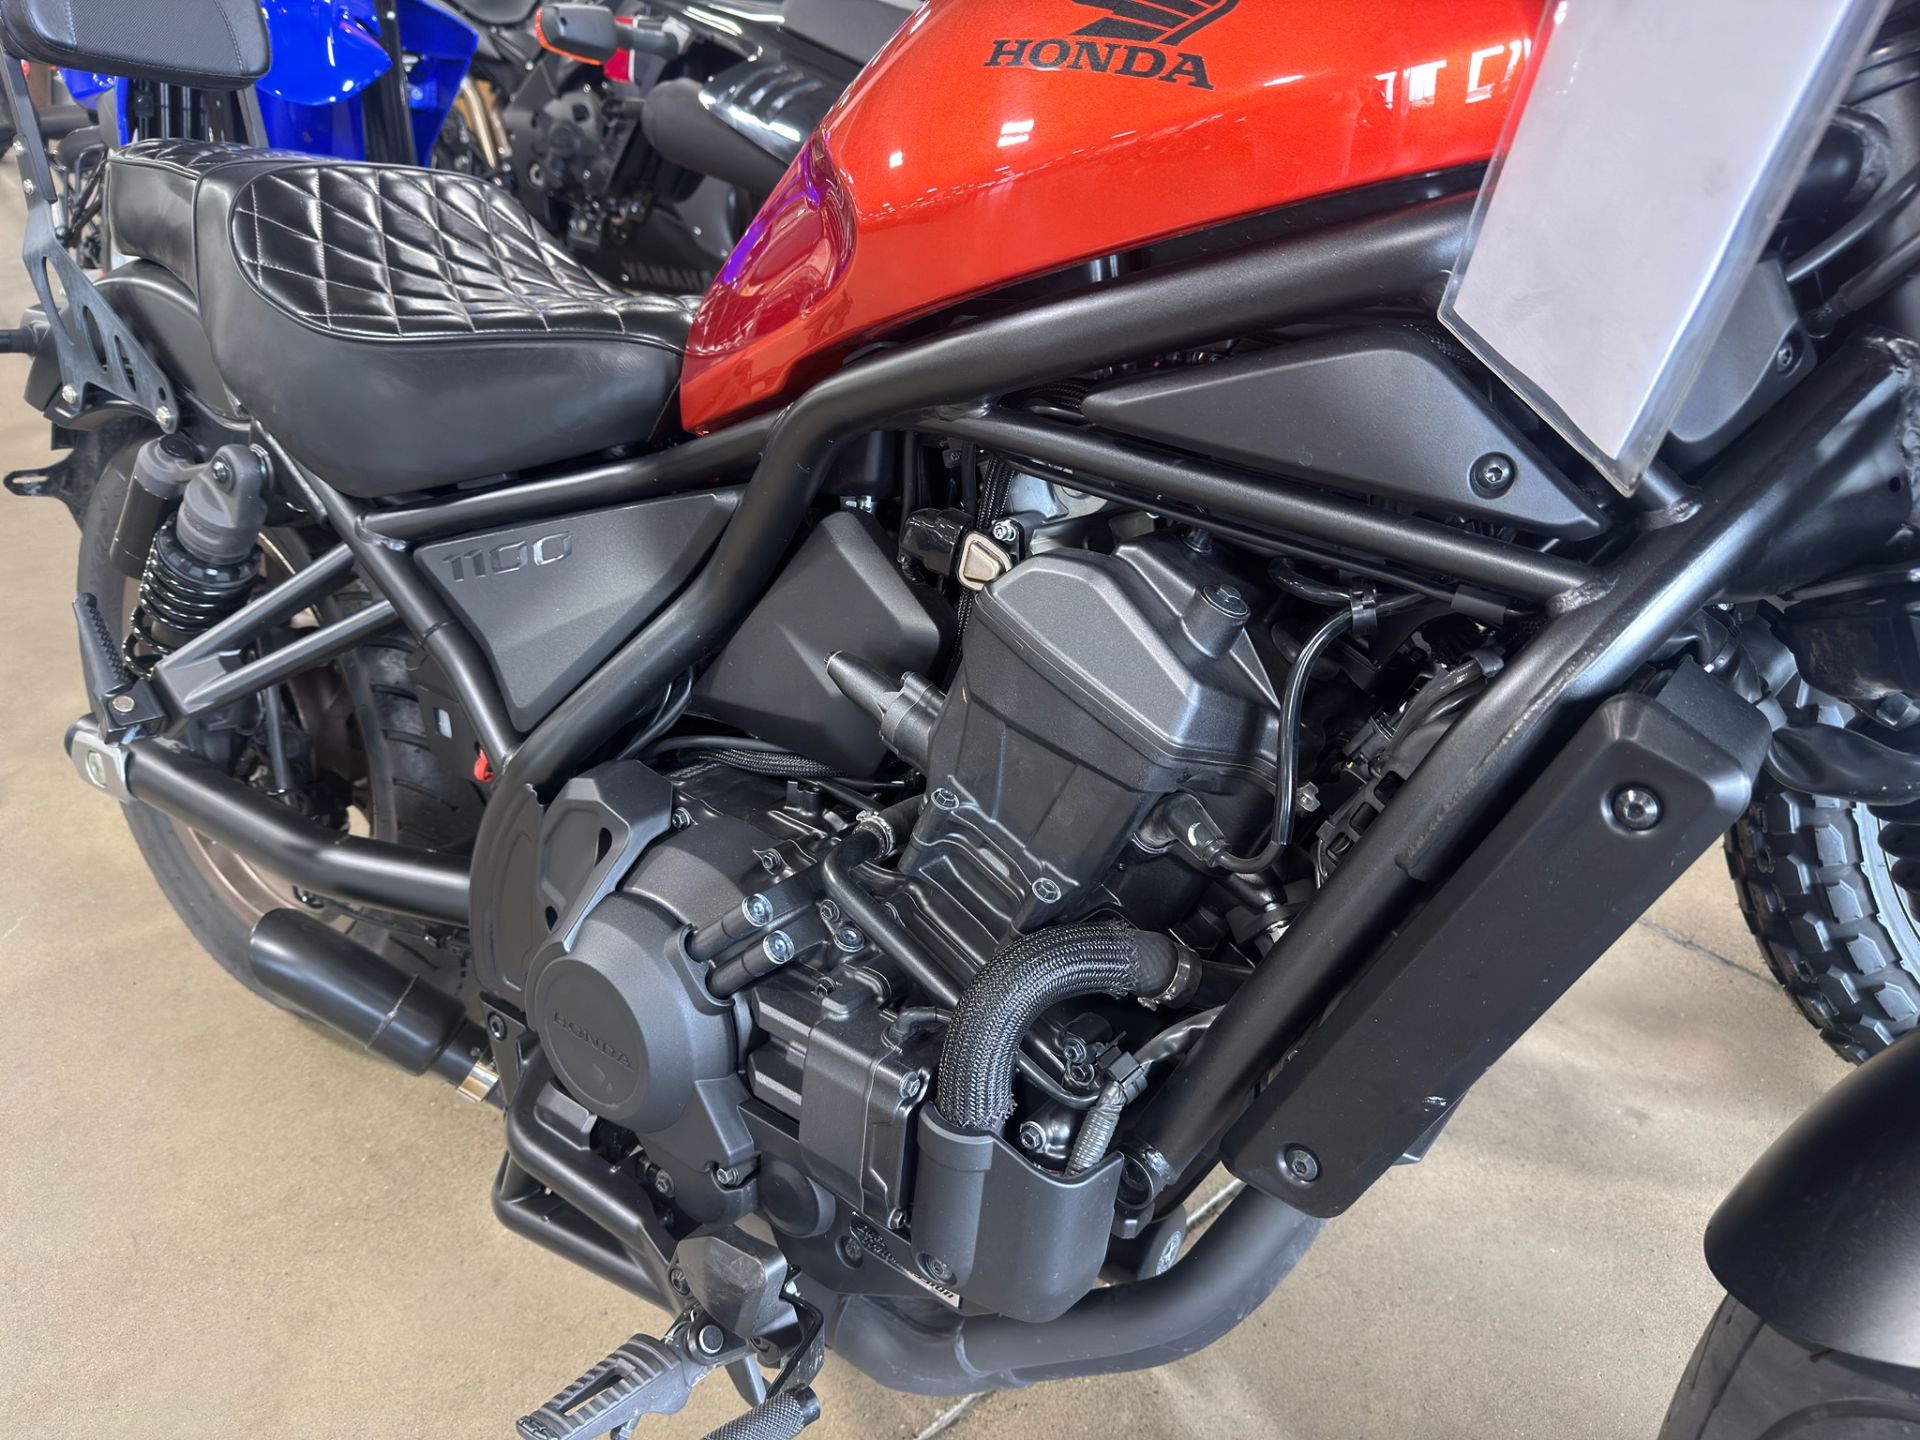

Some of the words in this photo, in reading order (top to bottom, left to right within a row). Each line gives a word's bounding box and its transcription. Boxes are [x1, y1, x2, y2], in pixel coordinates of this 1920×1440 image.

[983, 38, 1215, 91] HONDA
[442, 531, 573, 582] 1100
[552, 1010, 634, 1073] HONDA
